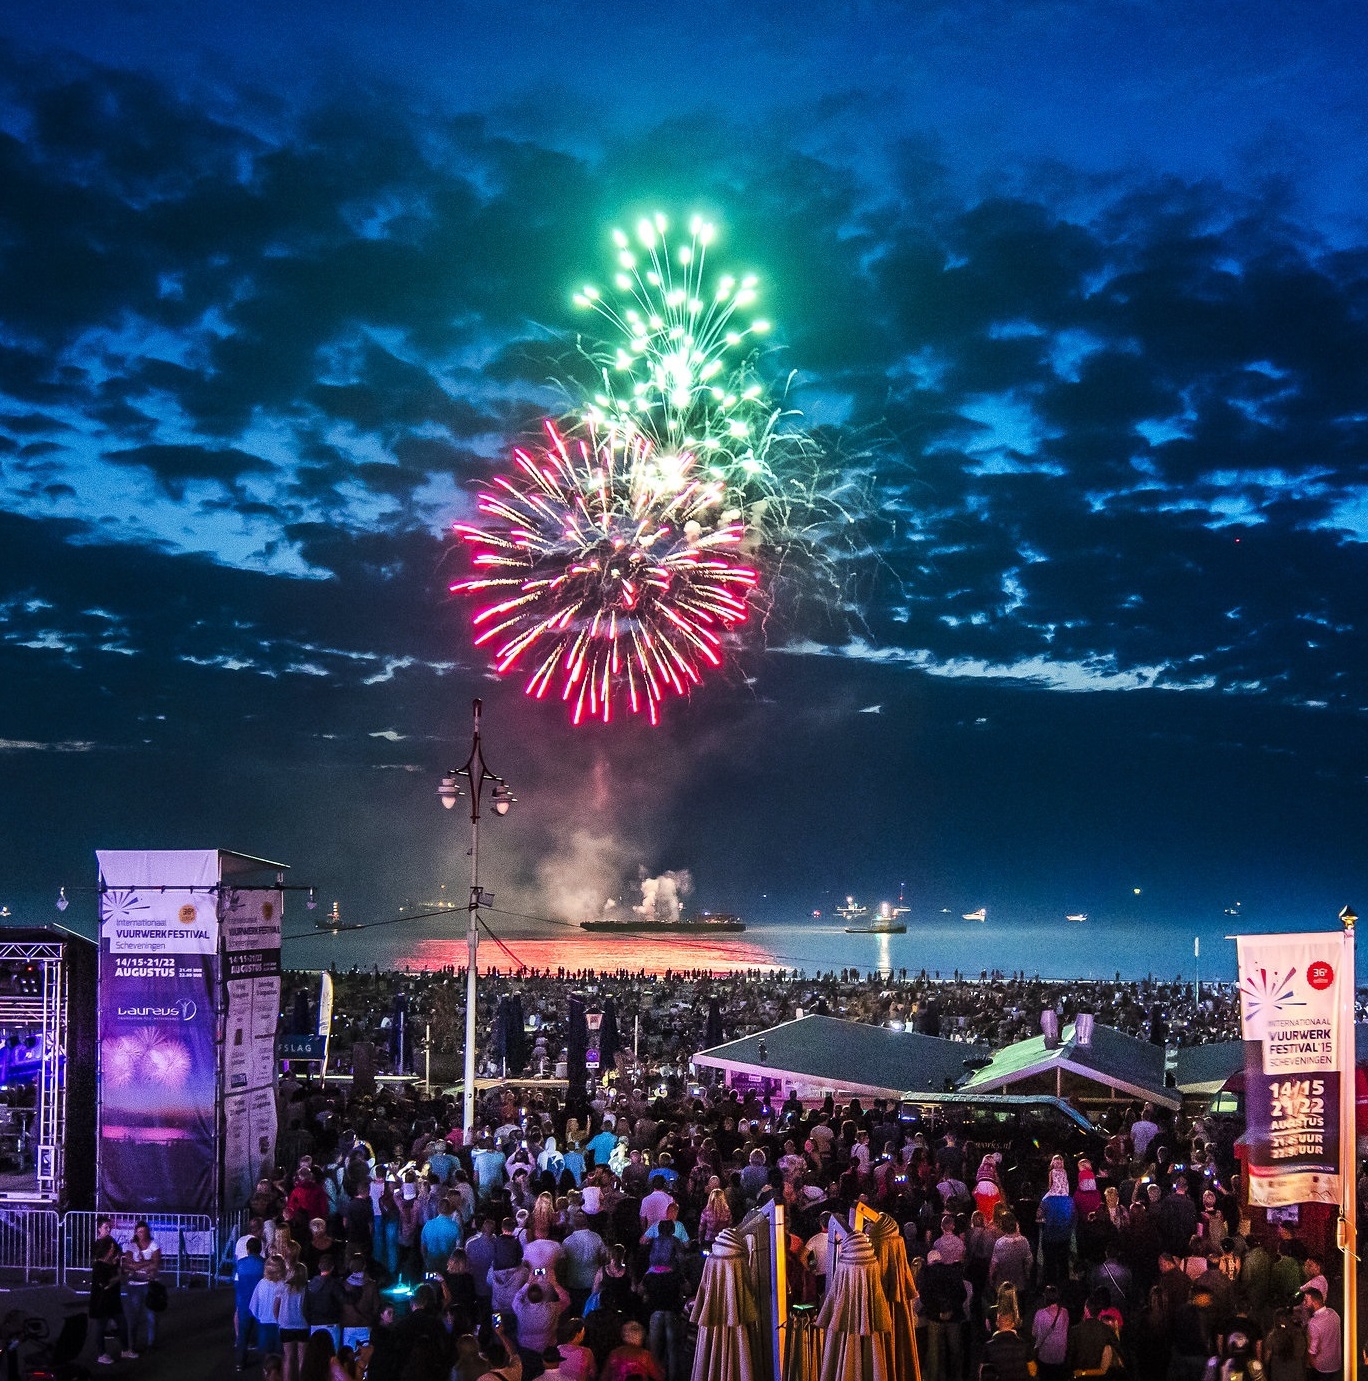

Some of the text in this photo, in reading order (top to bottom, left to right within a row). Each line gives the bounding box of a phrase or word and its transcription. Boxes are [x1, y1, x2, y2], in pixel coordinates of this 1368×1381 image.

[115, 942, 166, 951] Scheveningen
[114, 967, 176, 977] AUGUSTUS
[1268, 1019, 1331, 1027] INTERNATIONAAL
[1269, 1029, 1332, 1041] VUURWERK
[1270, 1055, 1333, 1067] SCHEVENINGEN
[1269, 1080, 1325, 1098] 14/15
[1270, 1098, 1325, 1117] 21/22
[1298, 1134, 1324, 1143] UUR
[1298, 1145, 1324, 1155] UUR
